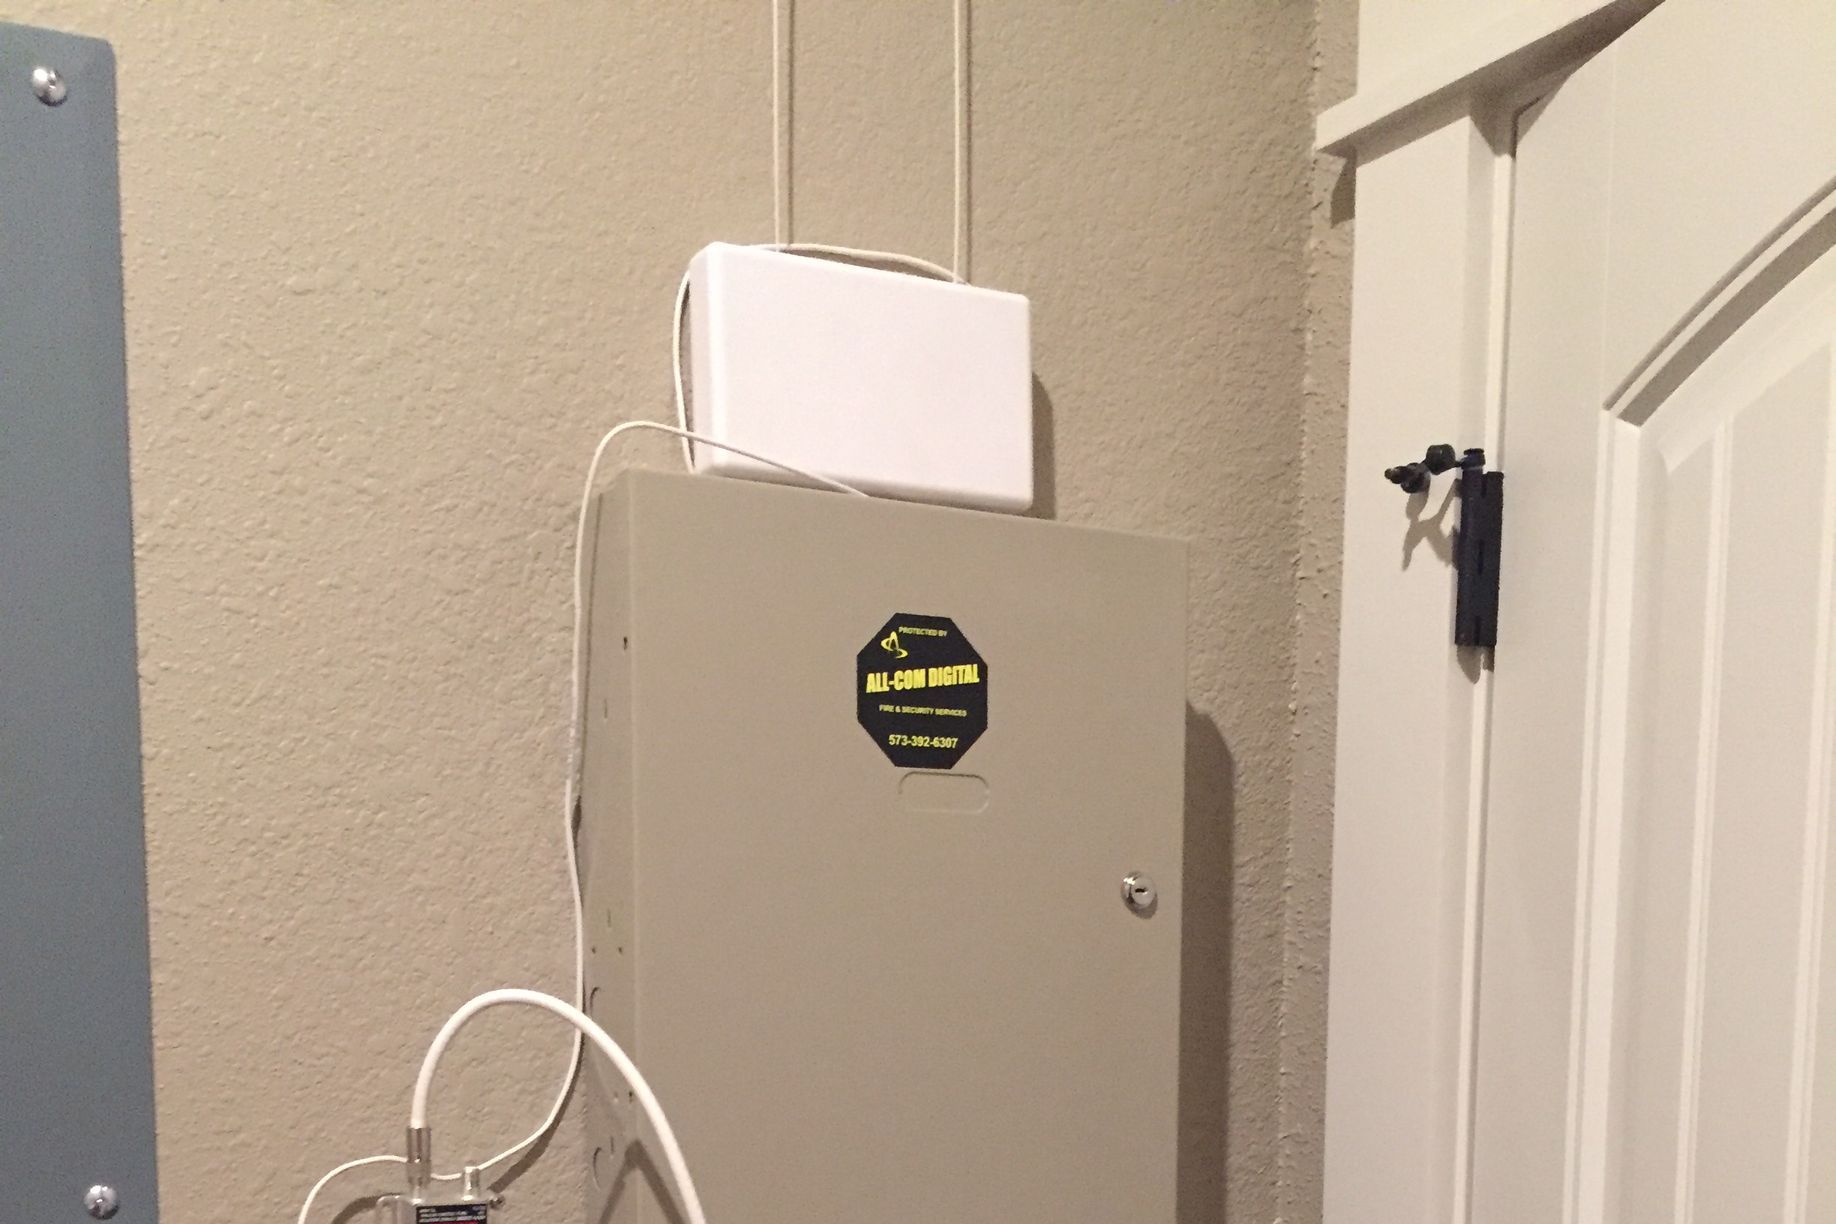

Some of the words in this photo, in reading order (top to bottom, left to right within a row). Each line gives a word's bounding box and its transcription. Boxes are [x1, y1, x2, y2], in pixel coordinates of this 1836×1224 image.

[866, 669, 926, 693] ALL-COM
[928, 664, 980, 687] DIGITAL
[878, 704, 895, 713] FIRE
[901, 706, 934, 715] SECURITY
[888, 734, 958, 749] 573-392-6307
